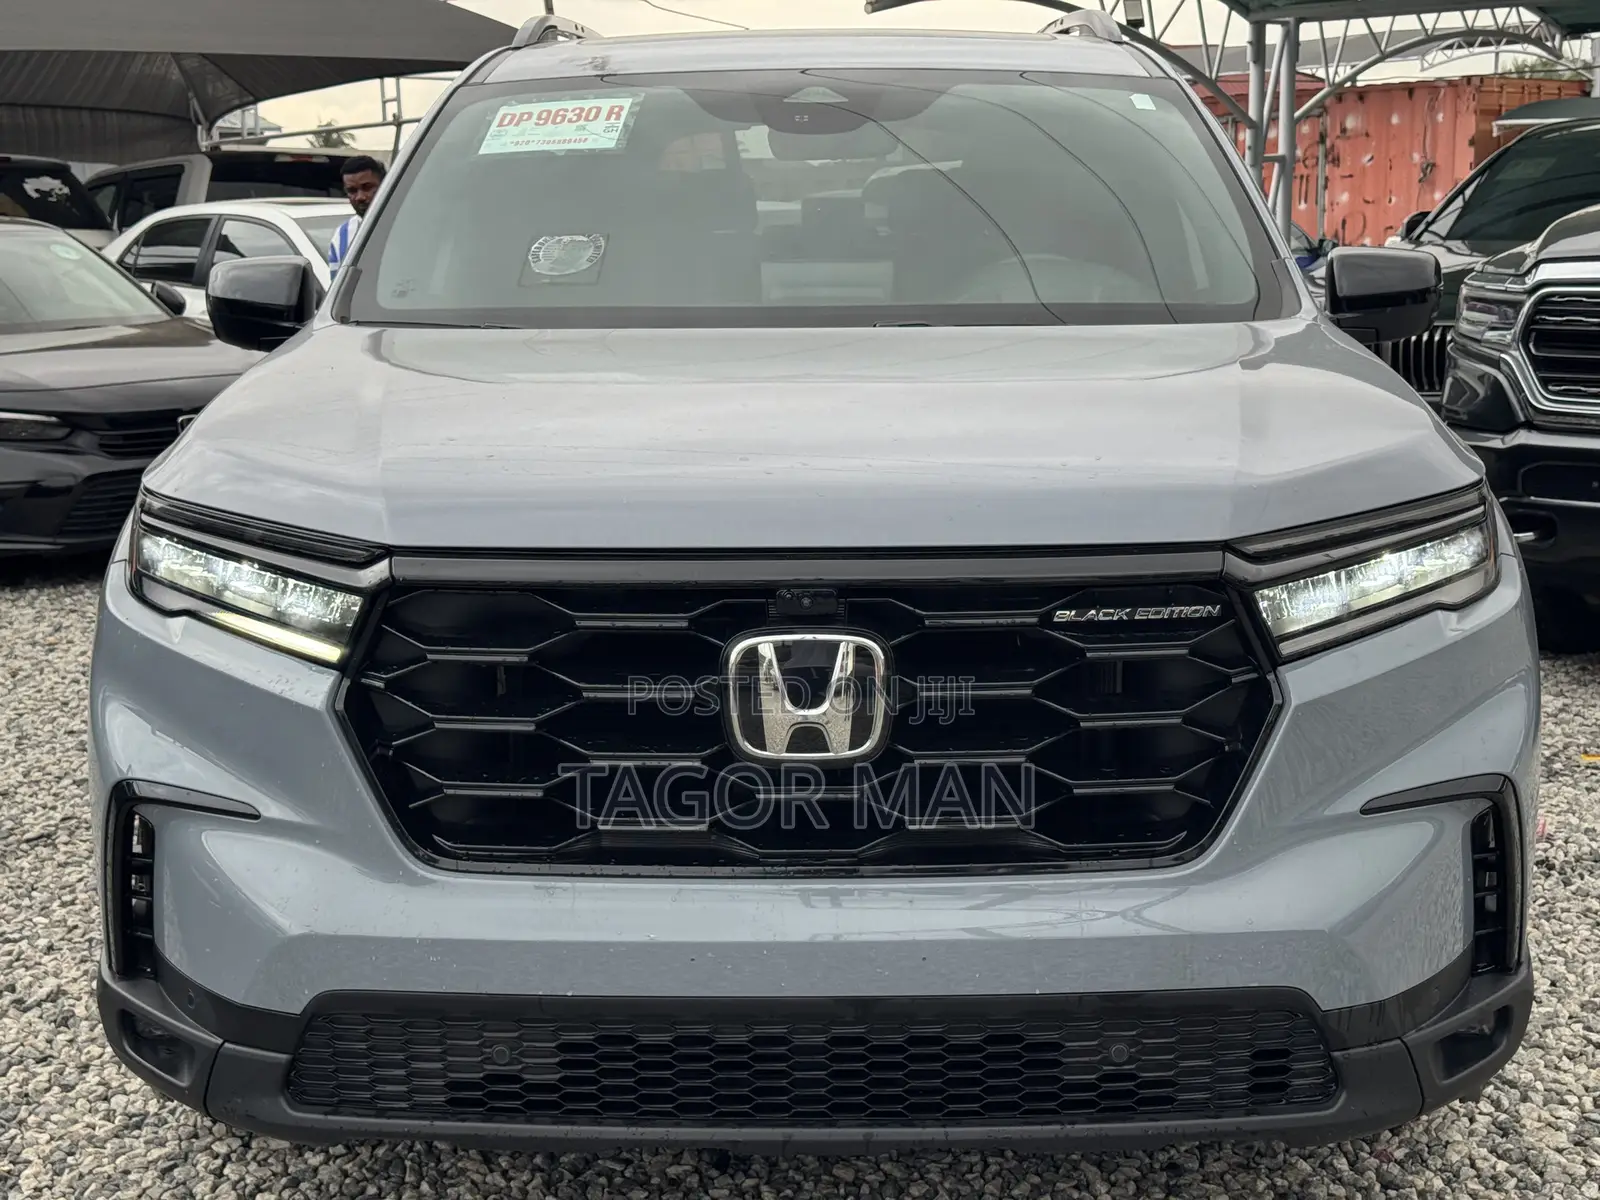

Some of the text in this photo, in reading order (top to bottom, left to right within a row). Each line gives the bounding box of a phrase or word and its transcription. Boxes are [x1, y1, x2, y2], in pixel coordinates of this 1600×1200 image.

[496, 104, 625, 128] DP 9630 R
[1052, 604, 1221, 622] BLACK EDITION
